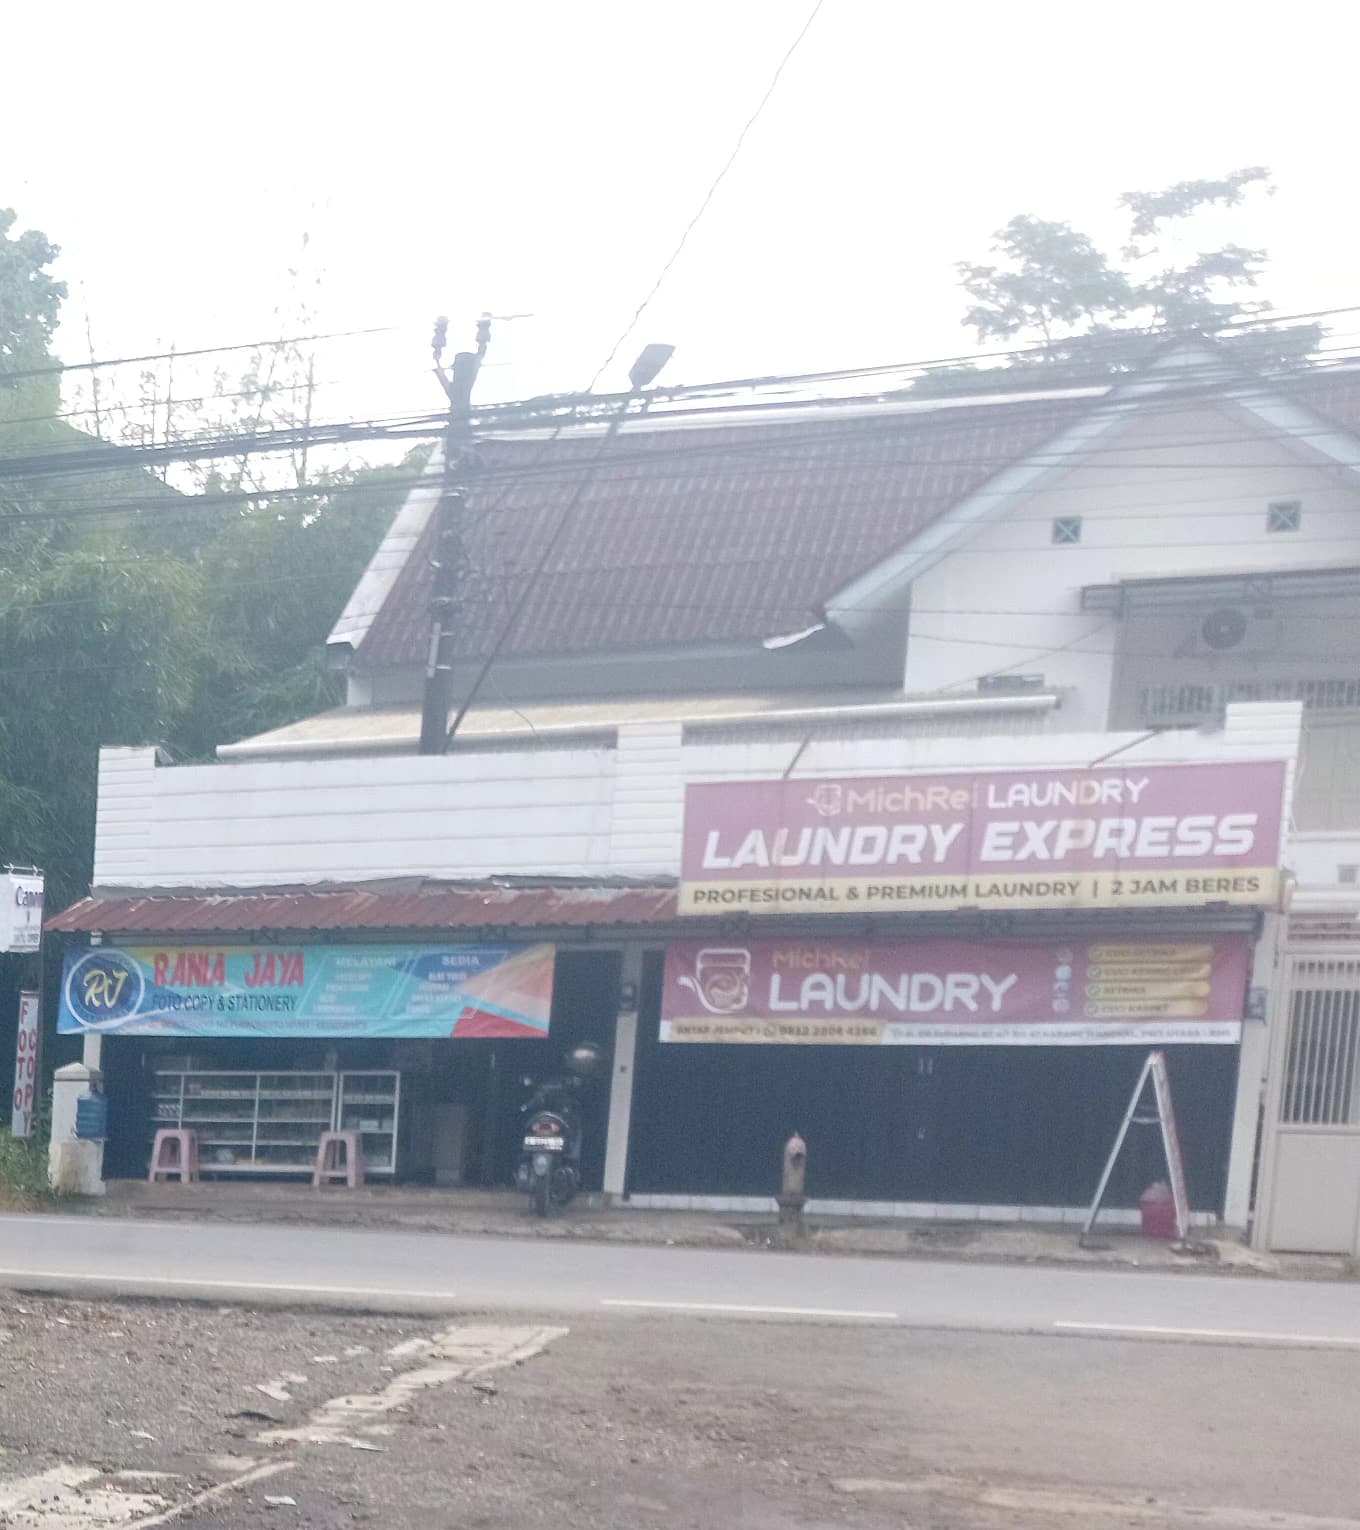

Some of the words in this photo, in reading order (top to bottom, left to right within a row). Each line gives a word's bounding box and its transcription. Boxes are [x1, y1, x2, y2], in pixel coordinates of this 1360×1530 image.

[987, 777, 1150, 809] LAUNDRY
[702, 822, 964, 869] LAUNDRY
[980, 813, 1259, 862] EXPRESS
[693, 884, 840, 905] PROFESIONAL
[846, 884, 860, 901] &
[866, 882, 968, 901] PREMIUM
[975, 880, 1080, 898] LAUNDRY
[1111, 879, 1125, 896] 2
[1129, 878, 1178, 896] JAM
[1184, 876, 1260, 895] BERES
[245, 951, 305, 987] JAYA
[228, 993, 298, 1016] STATIONERY
[768, 972, 1019, 1012] LAUNDRY
[14, 1001, 28, 1111] FOTO
